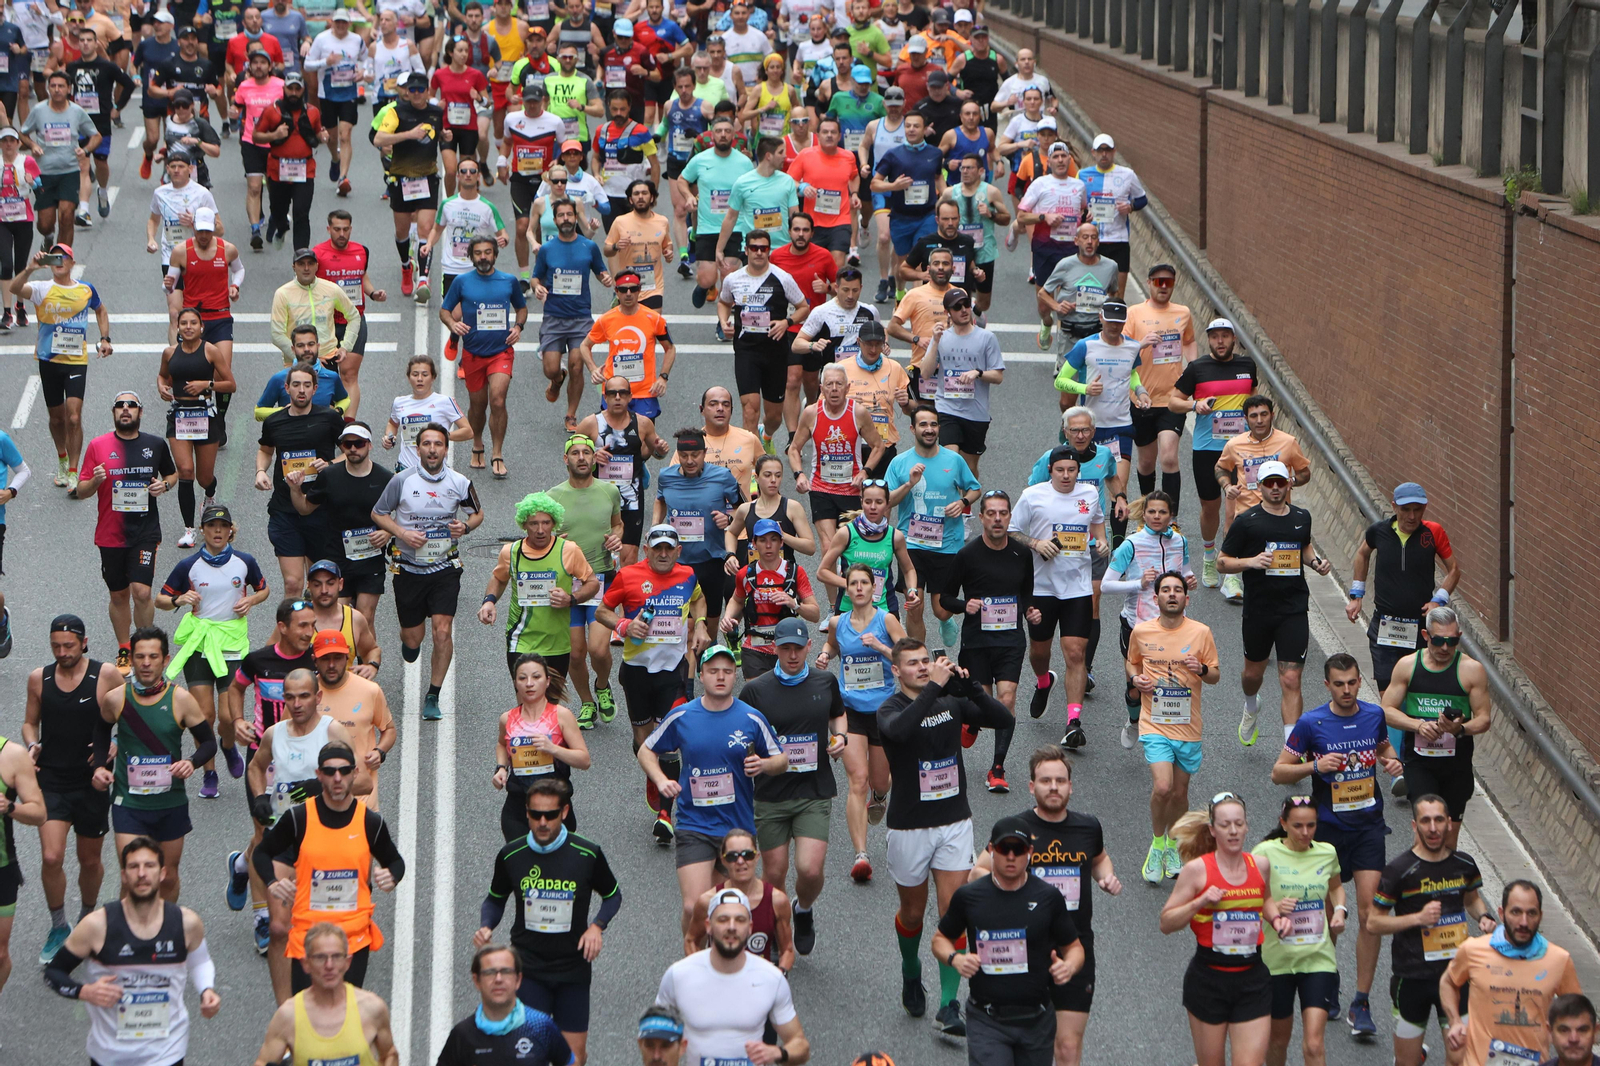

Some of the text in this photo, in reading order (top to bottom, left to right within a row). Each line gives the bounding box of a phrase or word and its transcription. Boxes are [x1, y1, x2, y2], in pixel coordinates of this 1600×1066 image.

[554, 84, 574, 95] FW
[109, 466, 153, 475] TRIATLETINES
[1417, 697, 1452, 707] VEGAN
[1327, 738, 1376, 750] BASTITANIA
[934, 759, 954, 768] ZURICH
[1347, 771, 1369, 780] ZURICH
[1031, 843, 1087, 864] parkrun
[1438, 916, 1462, 925] ZURICH
[992, 932, 1020, 940] ZURICH
[135, 994, 164, 1002] ZURICH
